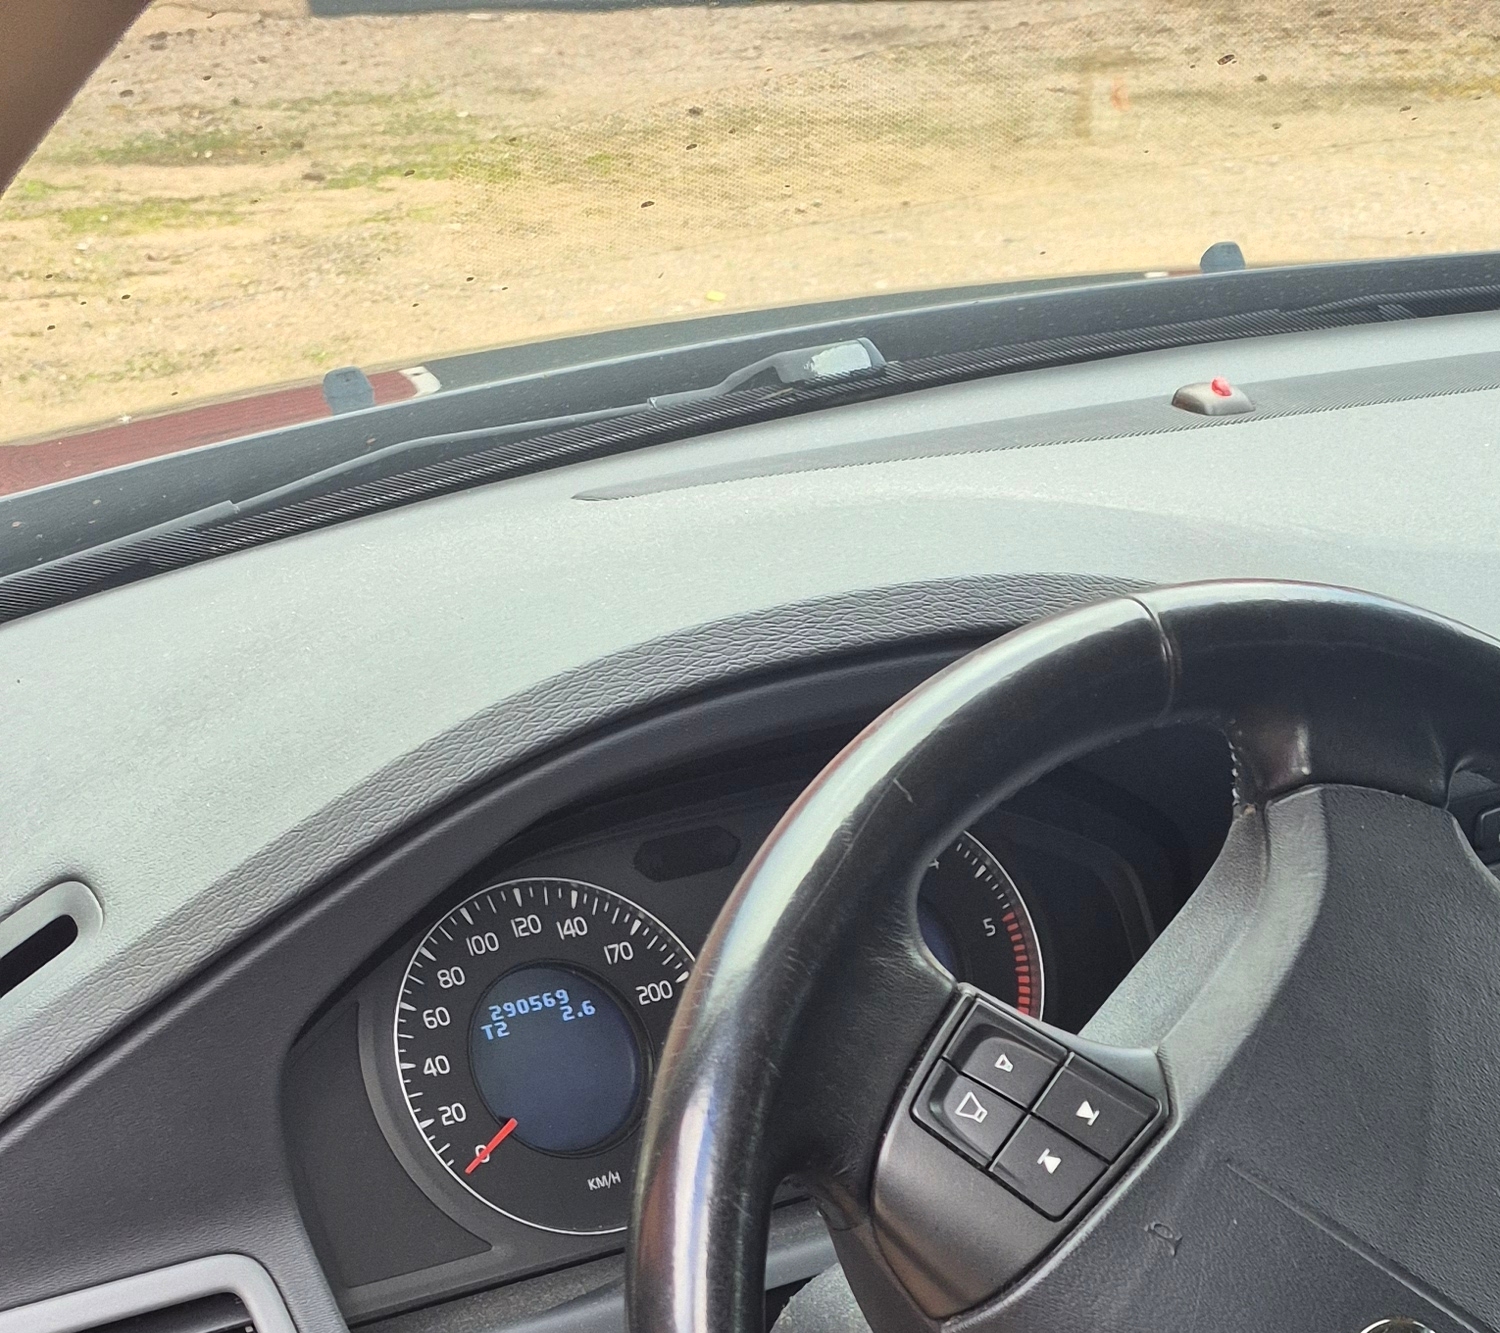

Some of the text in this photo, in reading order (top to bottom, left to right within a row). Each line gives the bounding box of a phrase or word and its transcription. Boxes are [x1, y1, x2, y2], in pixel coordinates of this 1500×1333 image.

[510, 914, 542, 938] 120
[556, 916, 588, 940] 140
[983, 917, 996, 937] 5
[466, 932, 499, 956] 100
[603, 941, 634, 965] 170
[436, 966, 466, 989] 80
[488, 989, 570, 1021] 290569
[635, 980, 673, 1006] 200
[422, 1006, 451, 1030] 60
[480, 1000, 596, 1041] T2 2.6
[422, 1055, 451, 1077] 40
[437, 1102, 467, 1126] 20
[587, 1170, 622, 1191] KM/H
